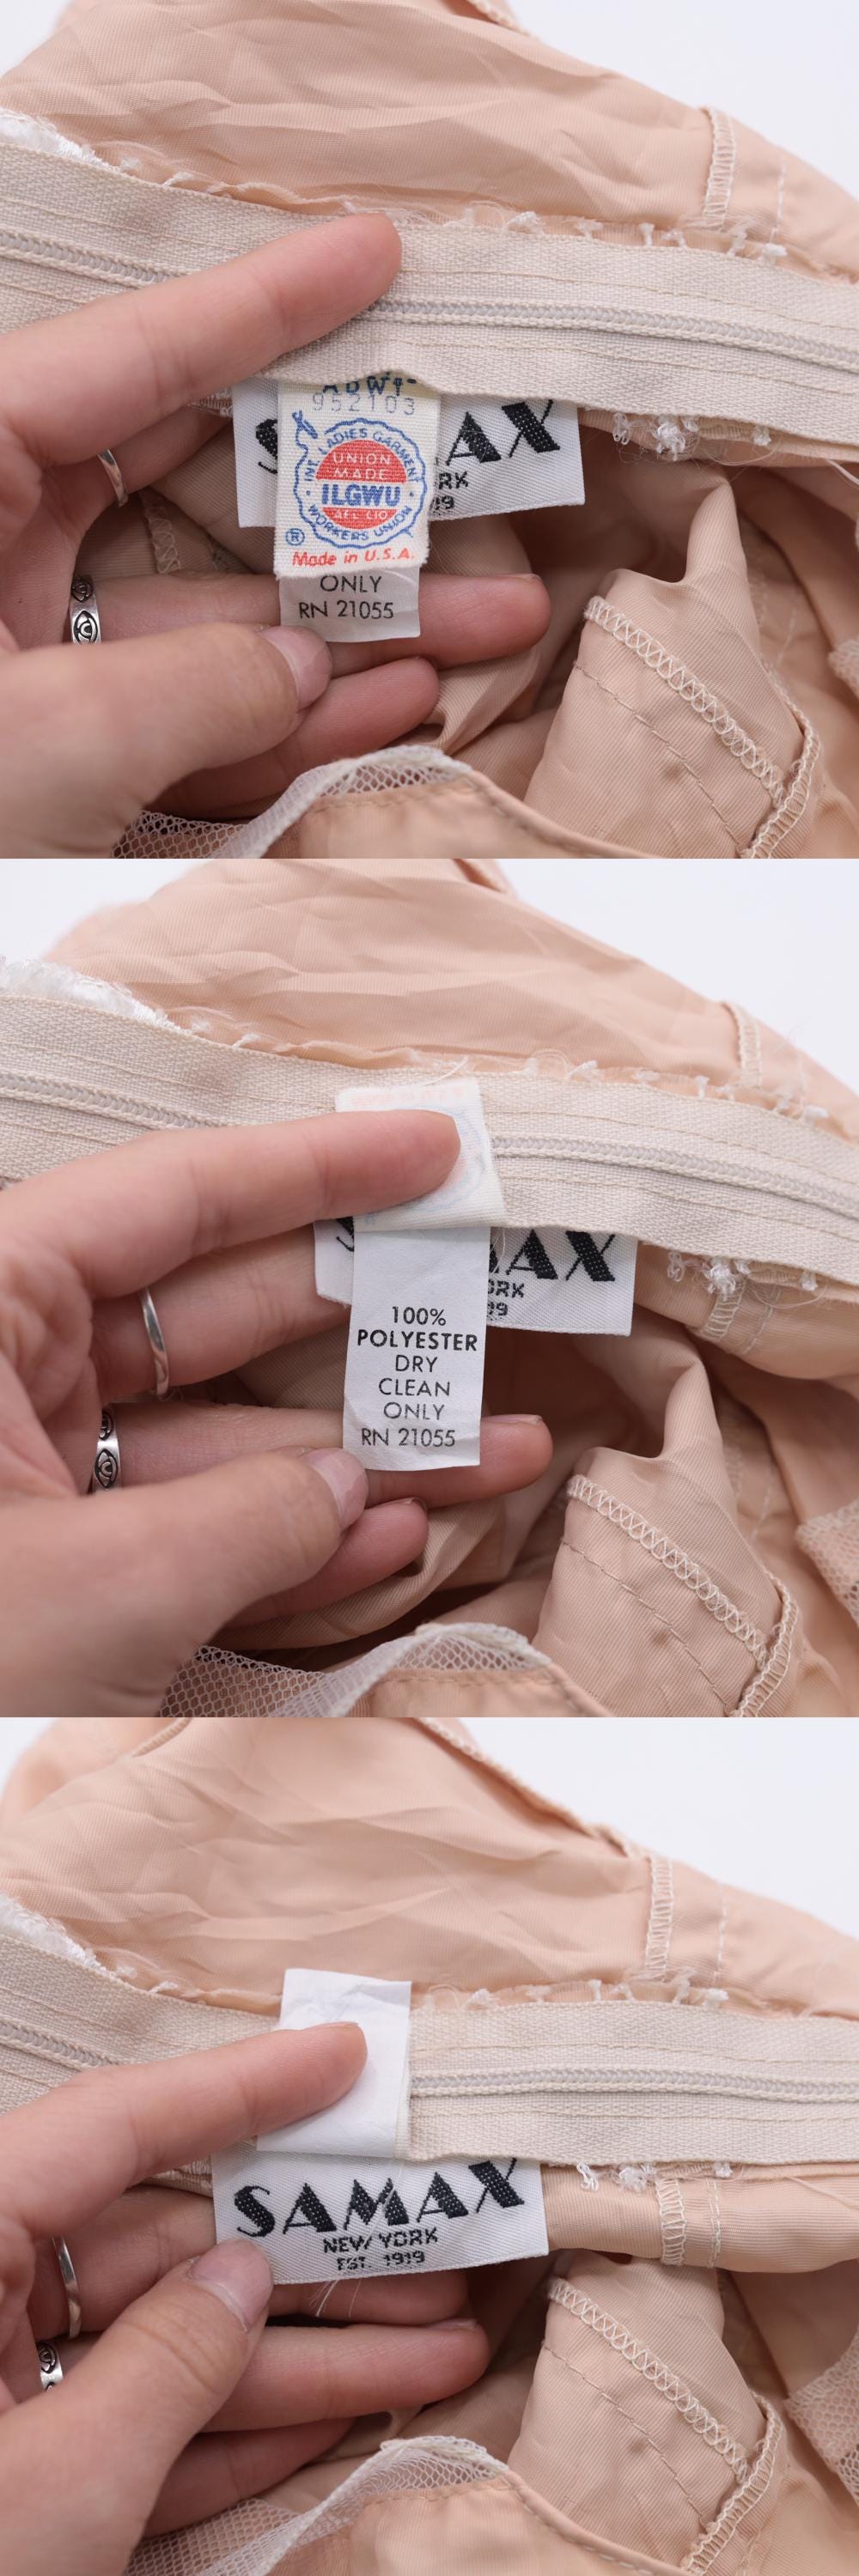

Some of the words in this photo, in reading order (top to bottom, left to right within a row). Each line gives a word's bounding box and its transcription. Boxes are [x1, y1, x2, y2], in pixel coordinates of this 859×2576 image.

[312, 392, 415, 416] 952103
[317, 428, 369, 457] LADIES
[372, 430, 422, 483] GARMENT
[332, 452, 392, 465] UNION
[333, 467, 391, 481] MADE
[321, 483, 401, 507] ILGWU
[308, 503, 369, 542] WORKERS
[373, 505, 413, 538] UNION
[292, 550, 338, 568] Made
[344, 550, 358, 564] in
[364, 547, 415, 563] U.S.A.
[320, 574, 382, 593] ONLY
[298, 601, 328, 619] RN
[336, 599, 394, 619] 21055
[392, 1306, 447, 1327] 100%
[357, 1328, 478, 1352] POLYESTER
[395, 1354, 438, 1373] DRY
[378, 1377, 451, 1397] CLEAN
[383, 1401, 445, 1421] ONLY
[361, 1427, 389, 1447] RN
[398, 1427, 456, 1448] 21055
[234, 2157, 525, 2238] SAMAX
[323, 2234, 373, 2254] NEW
[378, 2227, 438, 2249] YORK
[337, 2256, 372, 2271] EST.
[383, 2250, 426, 2267] 1919
